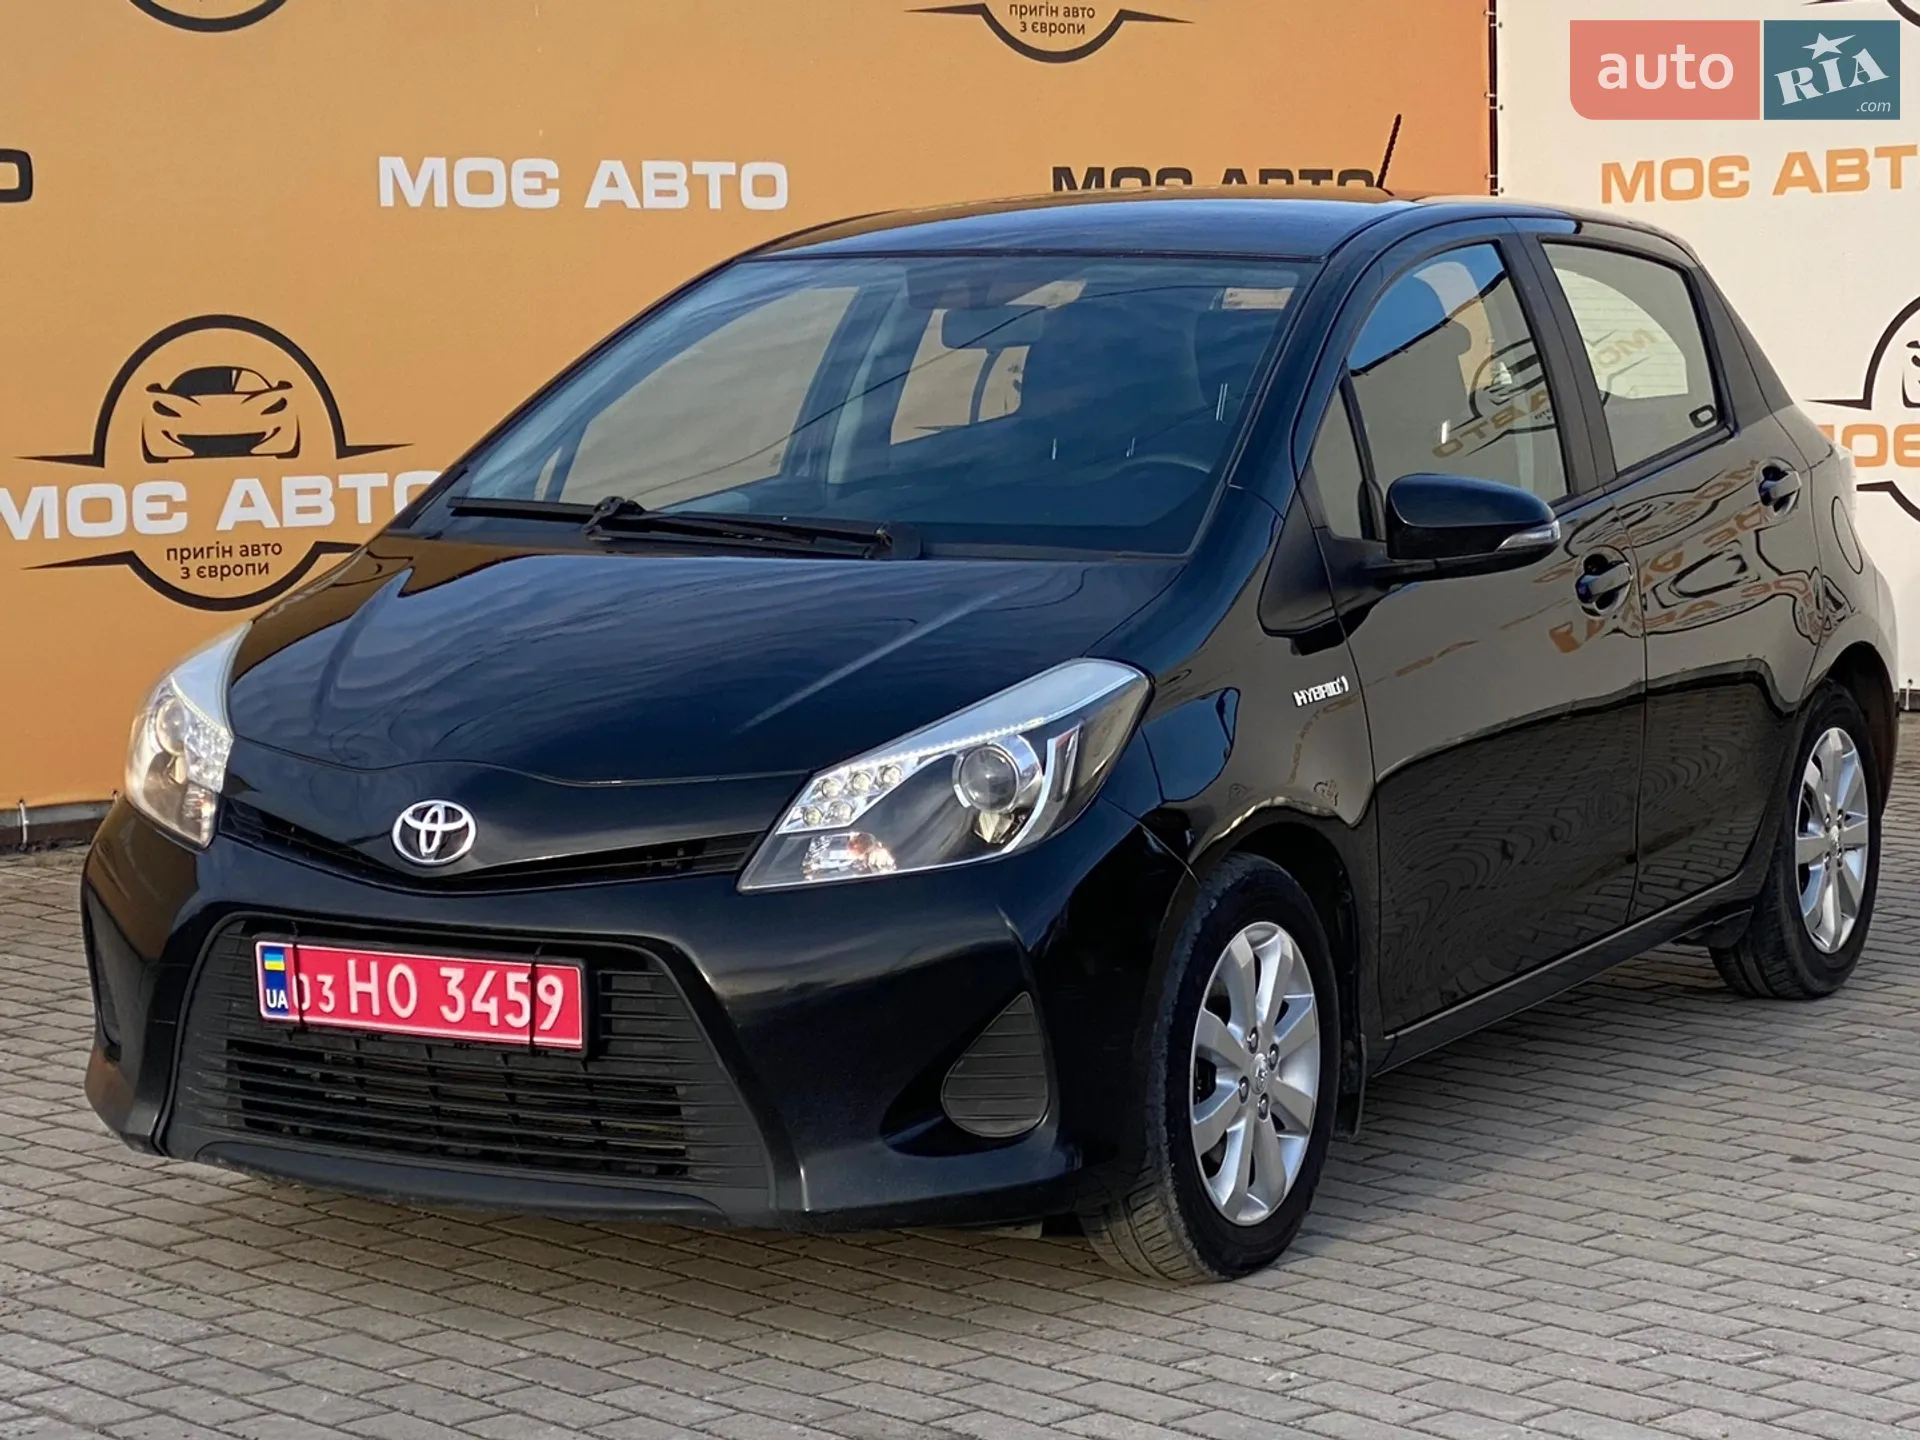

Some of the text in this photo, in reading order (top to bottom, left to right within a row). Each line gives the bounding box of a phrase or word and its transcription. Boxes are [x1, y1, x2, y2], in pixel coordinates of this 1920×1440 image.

[1009, 1, 1096, 19] пригін авто
[1020, 21, 1086, 36] з європи
[379, 156, 788, 210] МОЄ АВТО
[1602, 144, 1919, 204] МОЄ АВТ
[1816, 423, 1920, 468] ОЄ
[0, 481, 188, 540] МОЄ
[166, 541, 283, 563] пригін авто
[180, 561, 270, 581] з європи
[1293, 678, 1343, 707] HYBRID
[265, 988, 289, 1010] UA
[439, 967, 564, 1031] 3459
